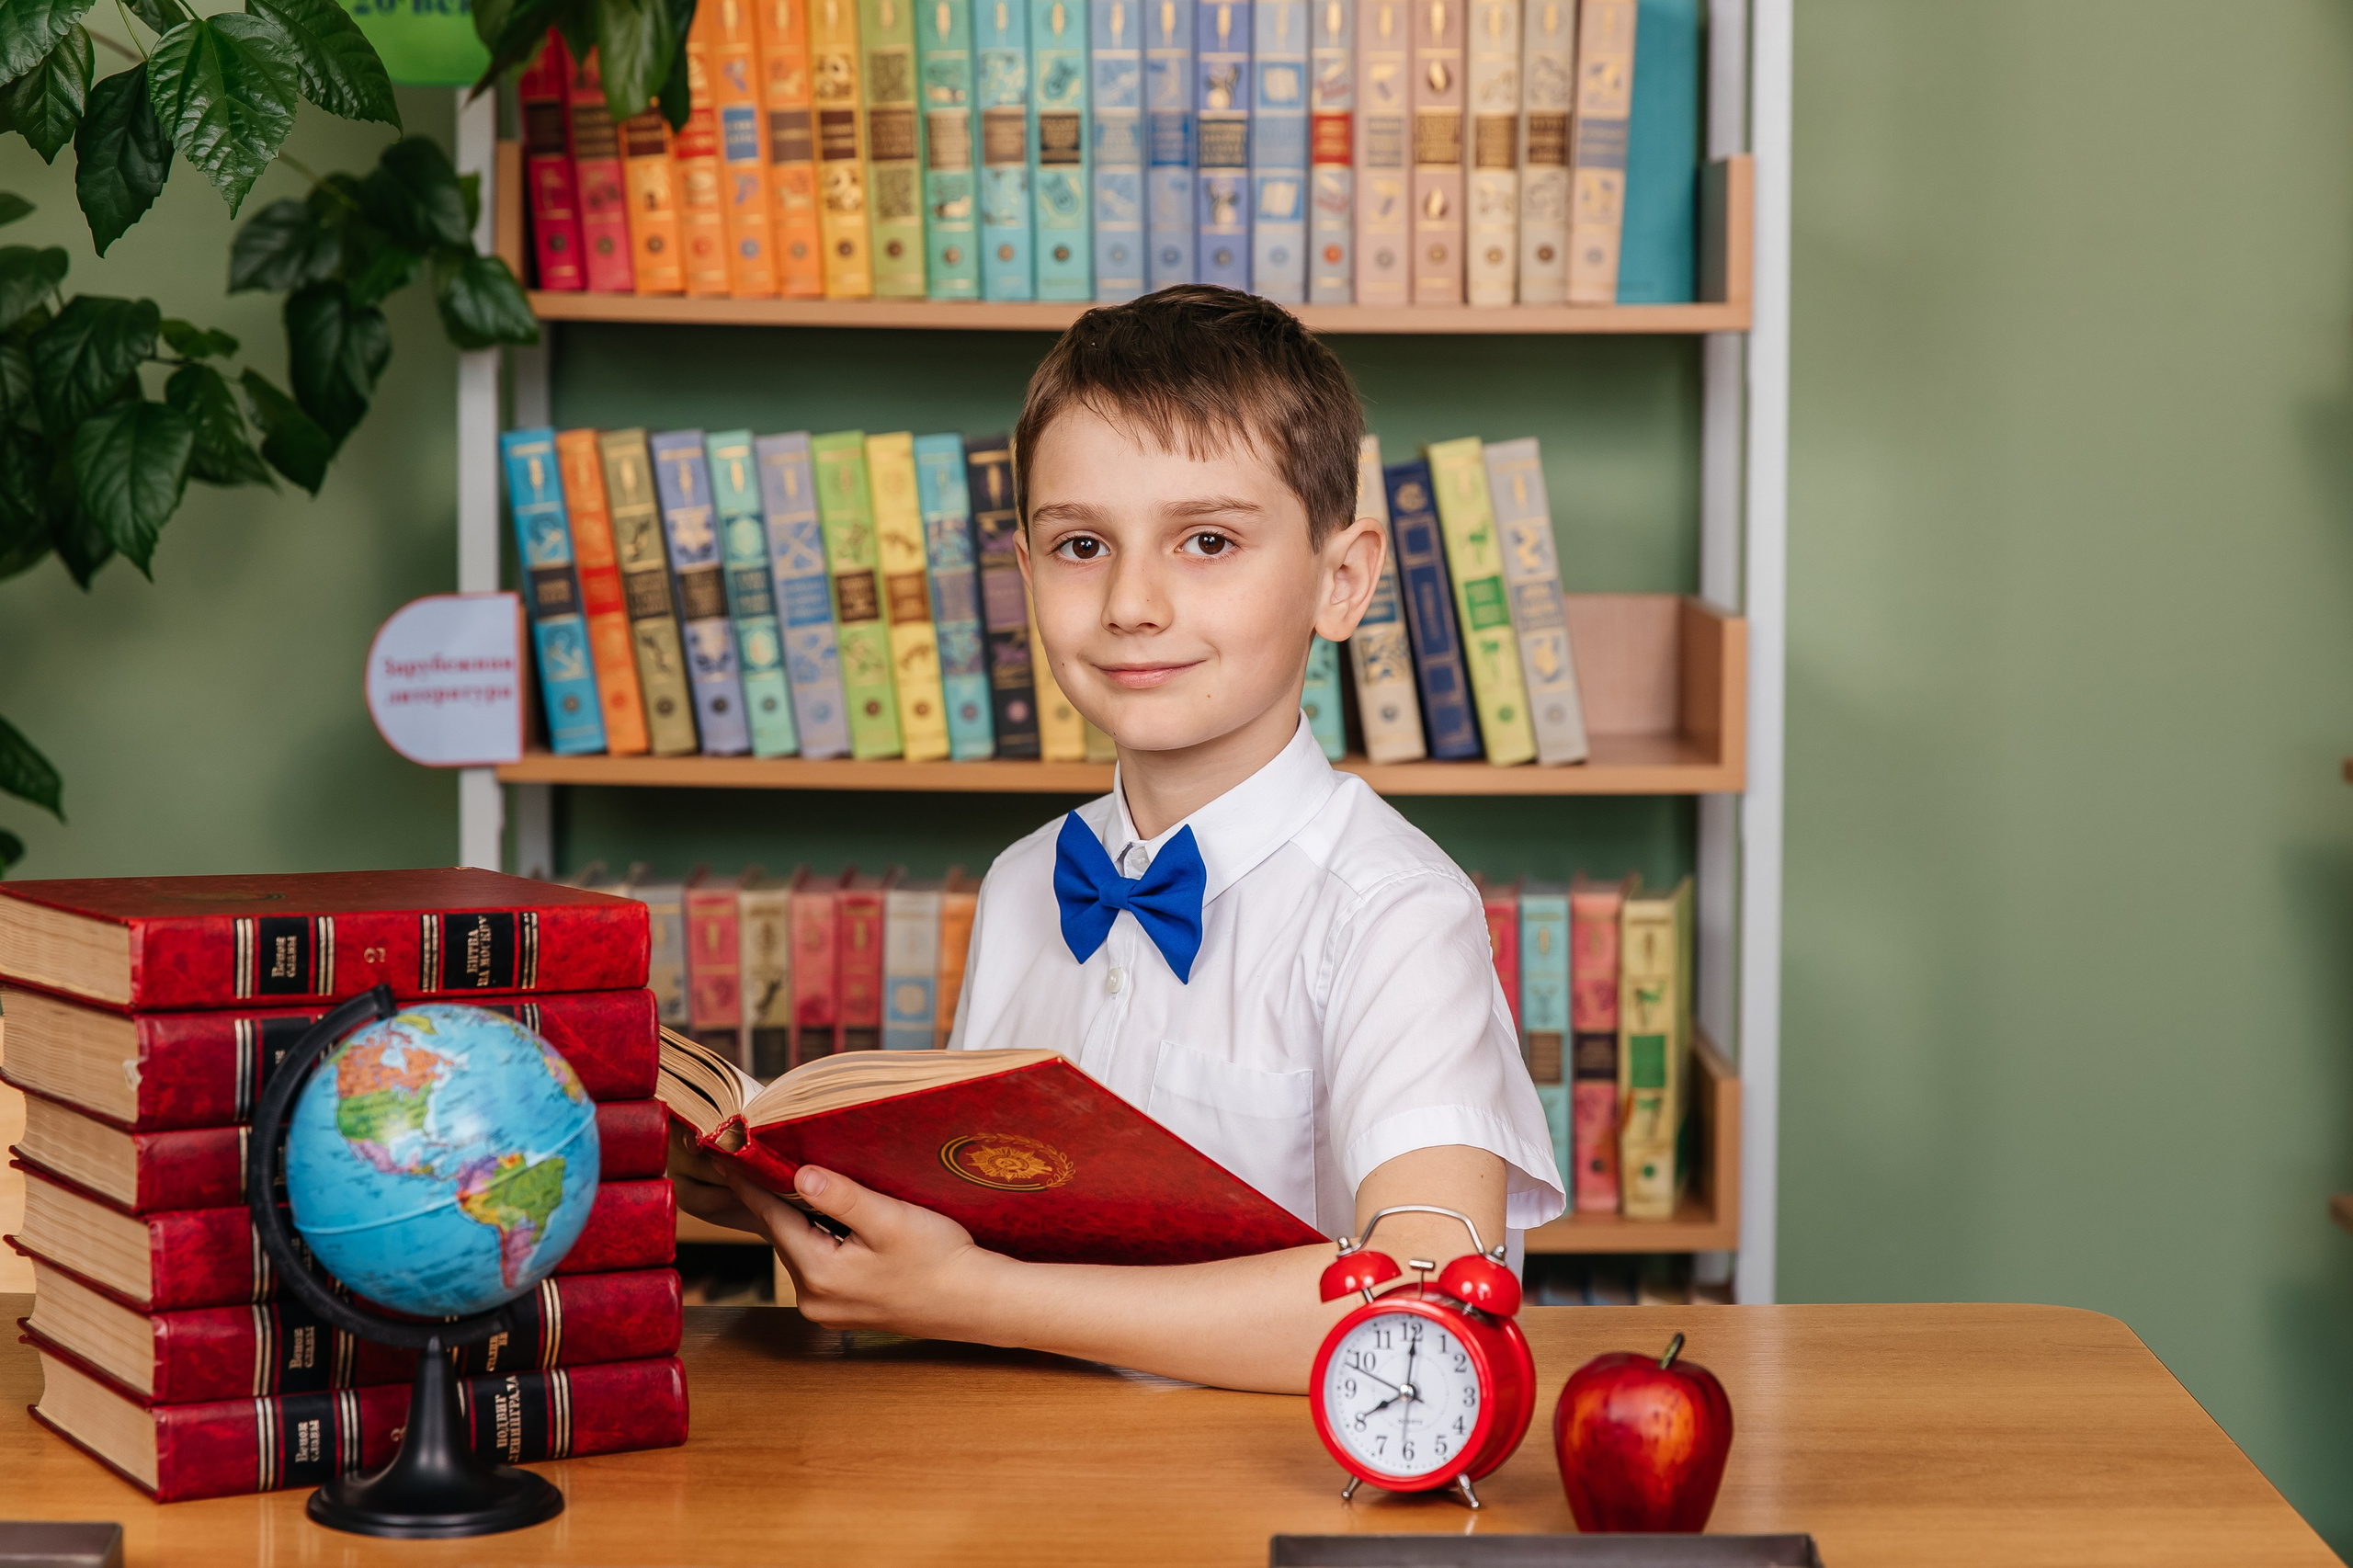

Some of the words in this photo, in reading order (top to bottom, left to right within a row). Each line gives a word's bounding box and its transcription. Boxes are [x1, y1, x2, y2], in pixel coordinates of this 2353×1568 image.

[364, 947, 386, 963] 2
[1375, 1330, 1392, 1349] 11
[1401, 1322, 1423, 1343] 12
[1438, 1335, 1448, 1354] 1
[1354, 1351, 1376, 1372] 10
[1453, 1353, 1468, 1373] 2
[1344, 1380, 1357, 1399] 9
[1463, 1387, 1475, 1407] 3
[494, 1393, 508, 1449] ПОДВИГ
[1354, 1413, 1367, 1432] 8
[1452, 1415, 1465, 1436] 4
[1375, 1436, 1388, 1455] 7
[1402, 1441, 1415, 1461] 6
[1435, 1435, 1448, 1456] 5
